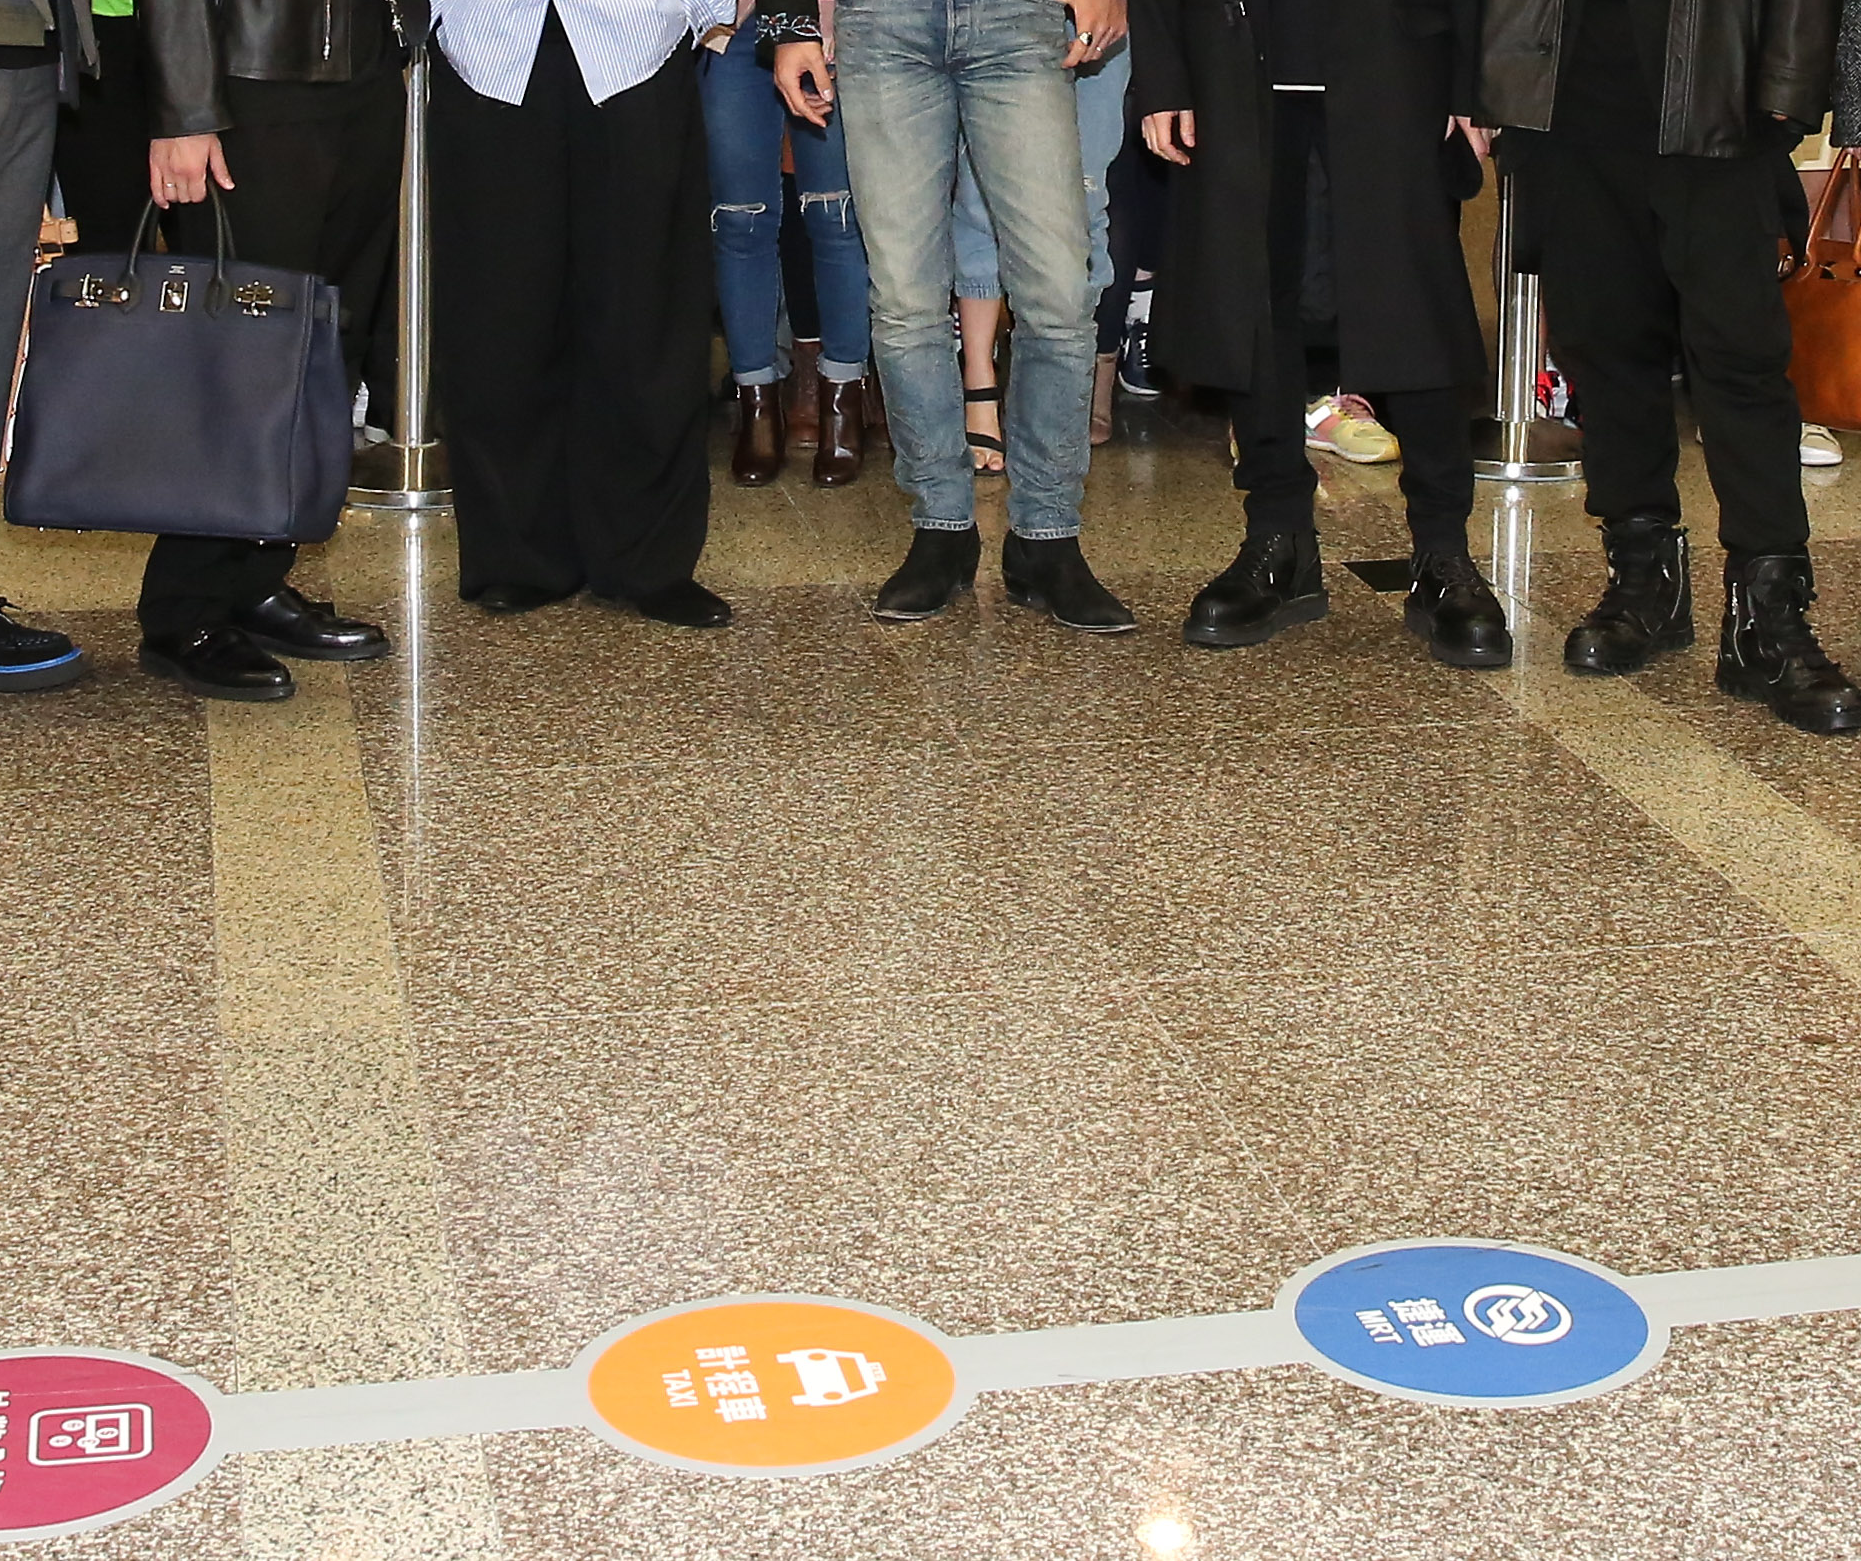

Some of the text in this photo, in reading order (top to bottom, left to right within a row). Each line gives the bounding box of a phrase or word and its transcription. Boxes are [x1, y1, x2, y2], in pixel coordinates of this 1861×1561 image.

[1355, 1309, 1404, 1344] MRT
[1387, 1296, 1467, 1348] 捷運
[661, 1368, 699, 1408] TAXI
[694, 1345, 768, 1423] 計程車
